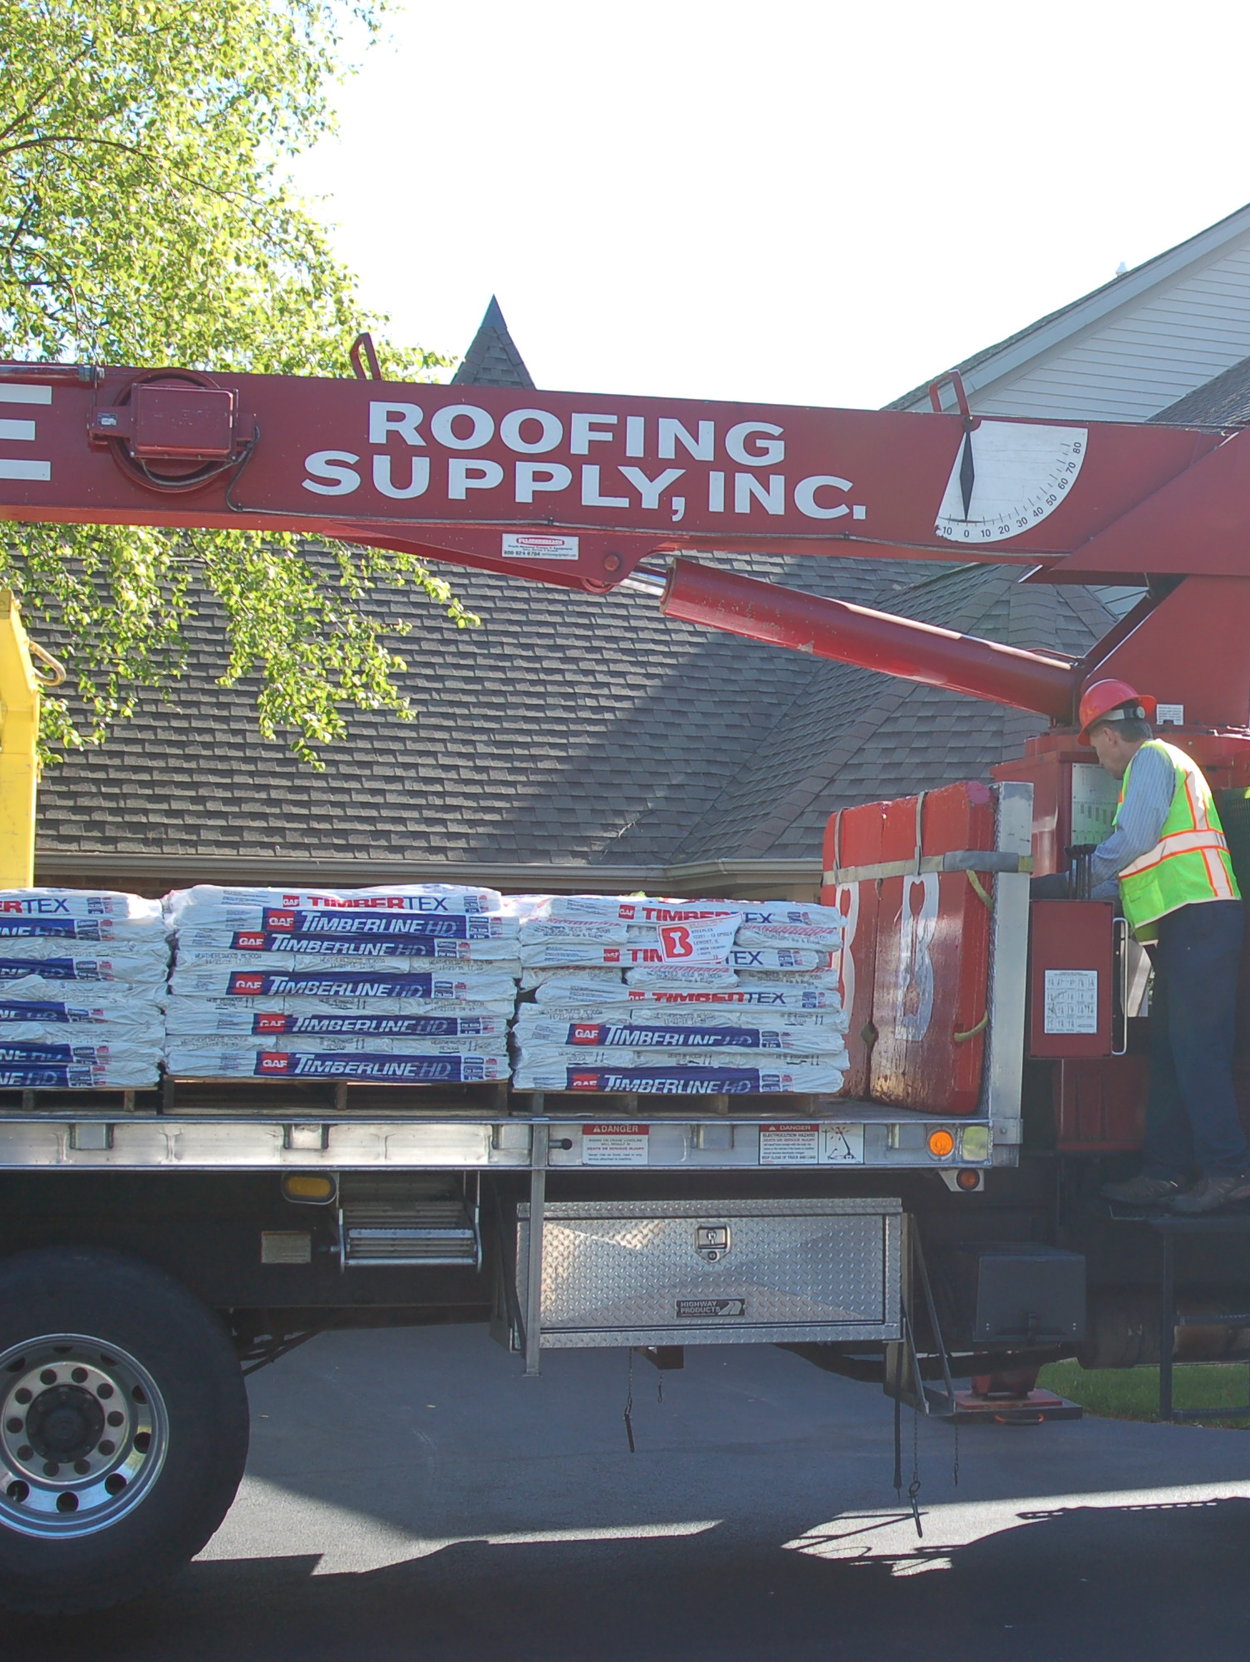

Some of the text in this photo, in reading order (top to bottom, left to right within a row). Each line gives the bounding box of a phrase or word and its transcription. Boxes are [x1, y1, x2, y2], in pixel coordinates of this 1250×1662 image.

[369, 401, 785, 467] ROOFING
[1065, 461, 1077, 475] 70
[301, 450, 866, 522] SUPPLY, INC.
[1057, 477, 1069, 490] 60
[1045, 494, 1058, 507] 50
[1032, 506, 1044, 518] 40
[1016, 516, 1028, 528] 30
[963, 529, 970, 538] 0
[981, 528, 991, 538] 10
[998, 524, 1011, 535] 20
[268, 917, 295, 926] GAF
[301, 911, 425, 934] TIMBERLINE
[238, 937, 265, 946] GAF
[271, 934, 395, 956] TIMBERLINE
[236, 980, 262, 989] GAF
[269, 976, 392, 996] TIMBERLINE
[292, 1015, 416, 1032] TIMBERLINE
[575, 1029, 599, 1038] GAF
[263, 1059, 288, 1067] GAF
[294, 1054, 420, 1076] TIMBERLINE
[604, 1075, 721, 1093] TIMBERLINE
[601, 1125, 639, 1133] DANGER
